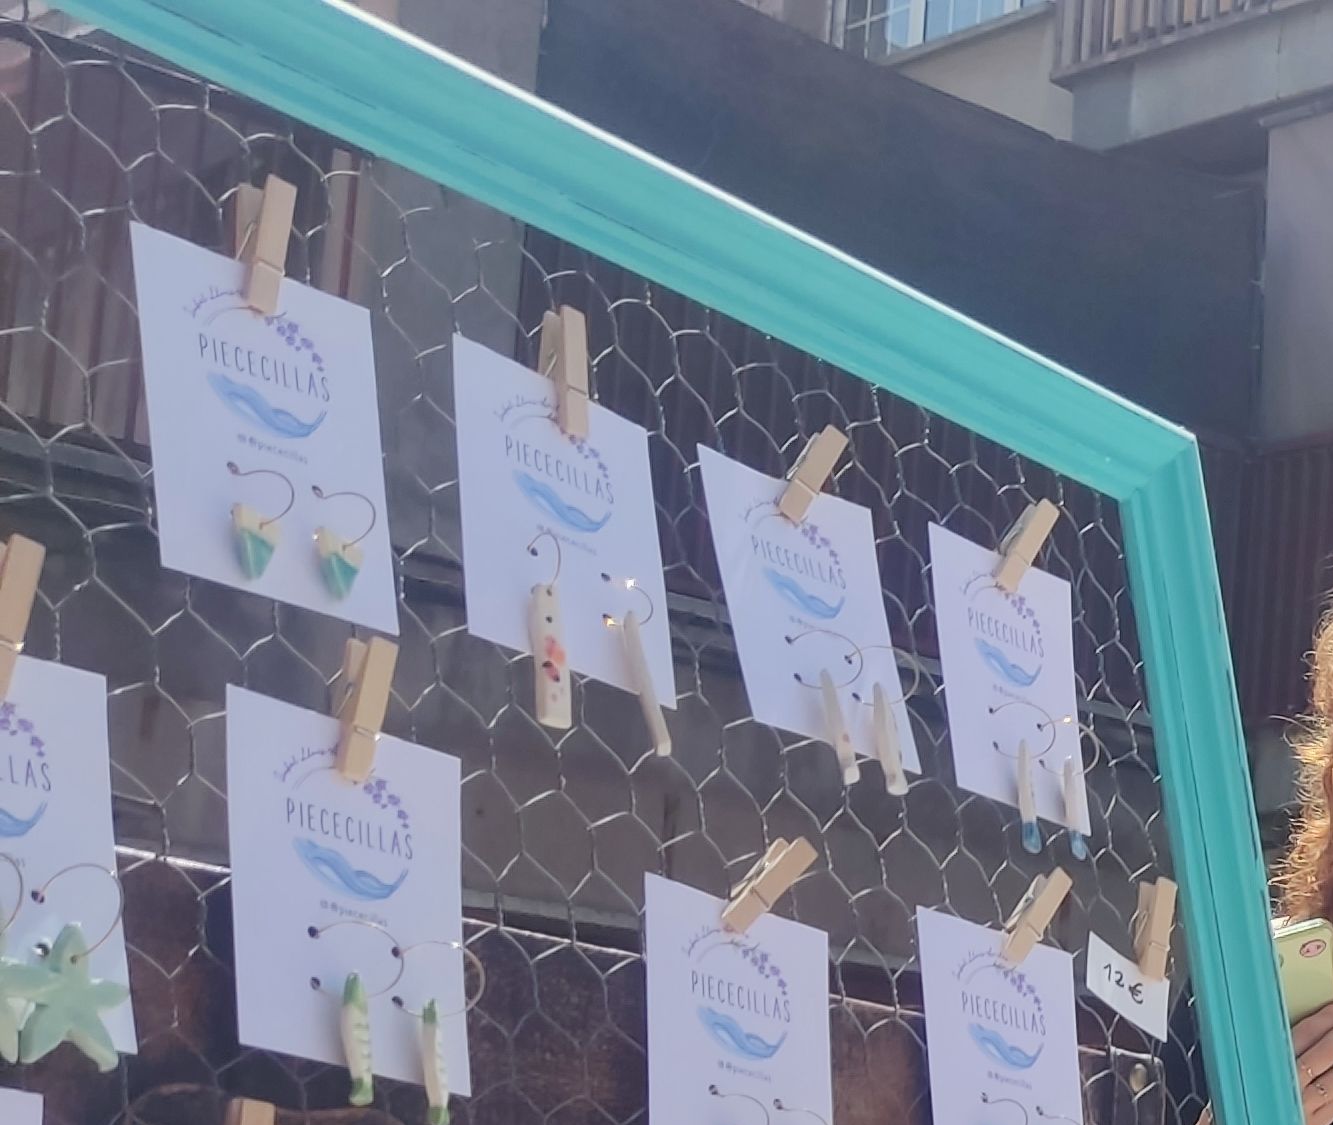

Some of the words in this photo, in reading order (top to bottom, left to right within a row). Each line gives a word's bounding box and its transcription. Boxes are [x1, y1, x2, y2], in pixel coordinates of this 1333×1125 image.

[199, 333, 330, 402] PIECECILLAS
[505, 435, 614, 504] PIECECILLAS
[751, 535, 846, 589] PIECECILLAS
[968, 607, 1044, 658] PIECECILLAS
[286, 797, 413, 860] PIECECILLAS
[691, 970, 791, 1023] PIECECILLAS
[962, 991, 1046, 1036] PIECECILLAS
